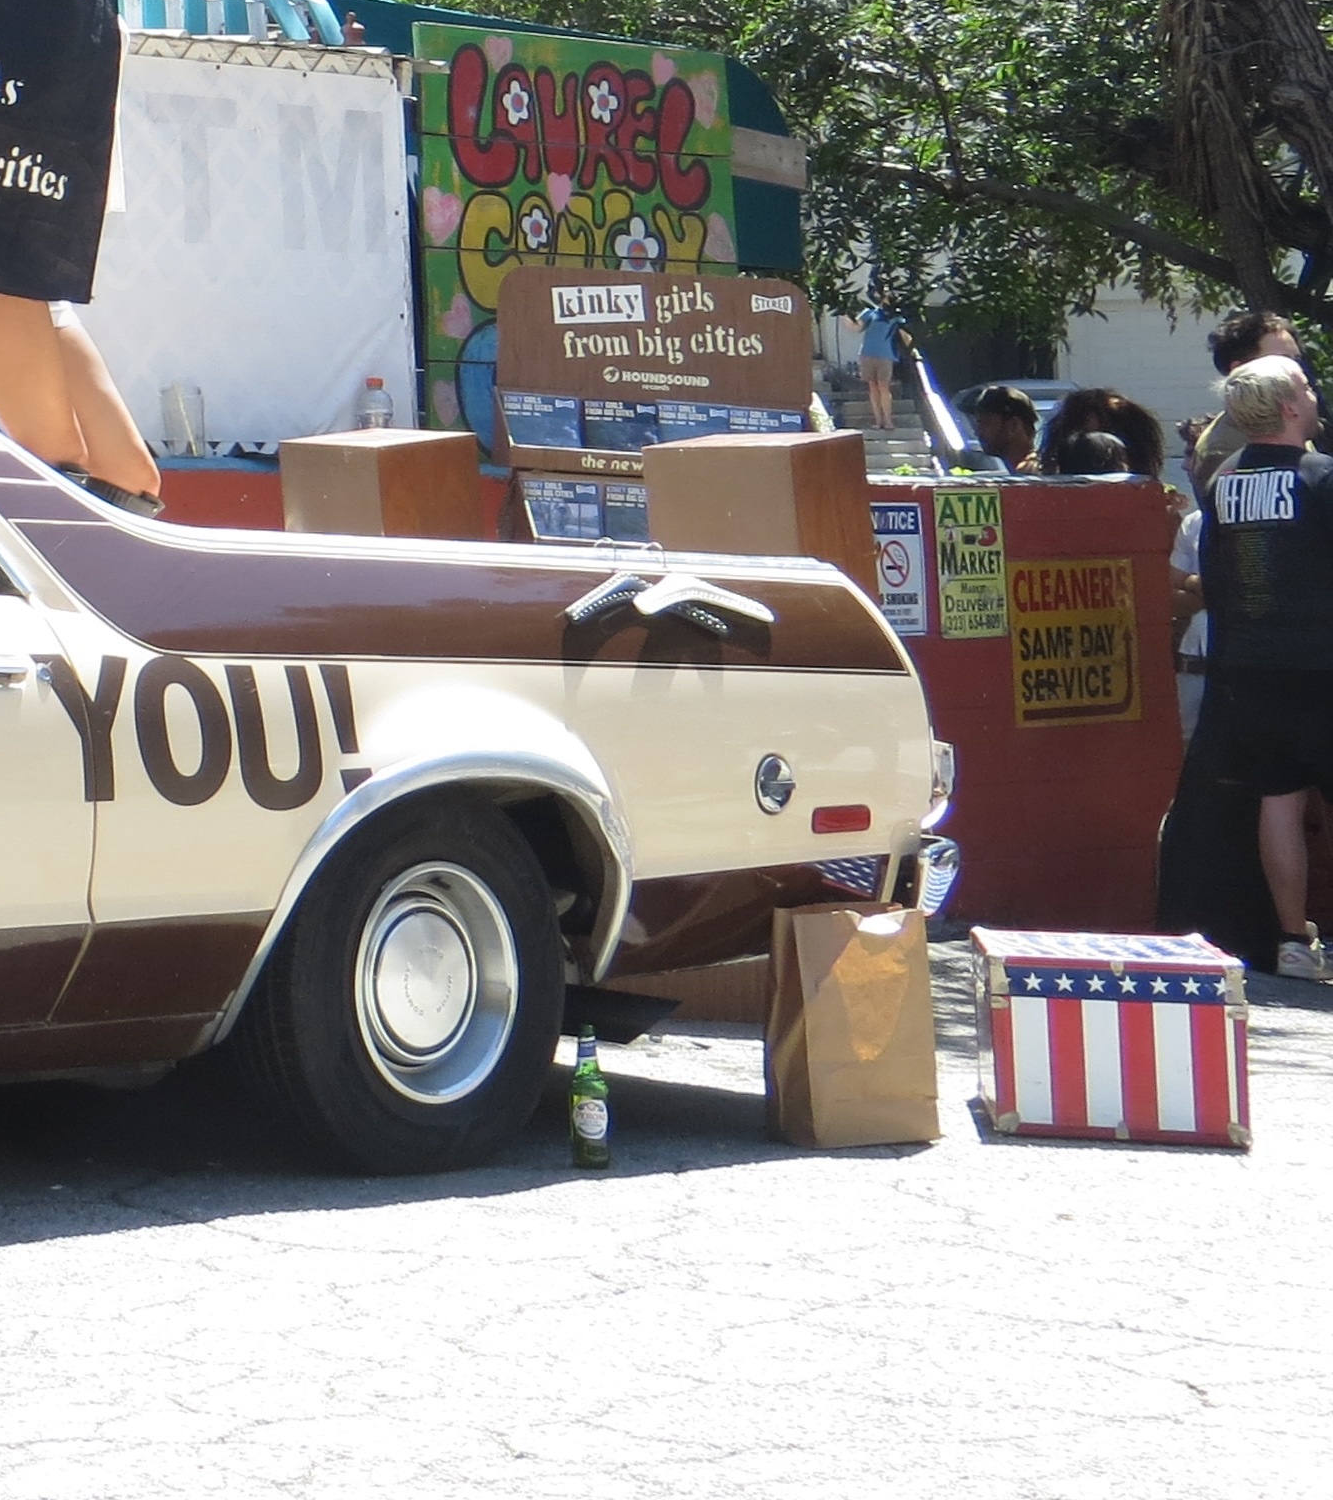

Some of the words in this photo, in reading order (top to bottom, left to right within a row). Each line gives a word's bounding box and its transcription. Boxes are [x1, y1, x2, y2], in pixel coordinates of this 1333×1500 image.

[447, 43, 712, 211] LAUREL
[557, 287, 640, 320] kinky
[655, 281, 715, 324] girls
[753, 297, 790, 312] STEREO
[563, 330, 630, 359] from
[637, 328, 684, 365] big
[690, 324, 763, 357] cities
[621, 370, 710, 387] HOUNDSOUND
[581, 454, 606, 469] the
[610, 459, 645, 471] new
[938, 496, 999, 525] ATM
[1215, 469, 1295, 525] DEFTONES
[1013, 567, 1129, 613] CLEANERS
[1080, 624, 1115, 657] DAY
[1021, 664, 1113, 703] SERVICE
[29, 654, 374, 811] YOU!
